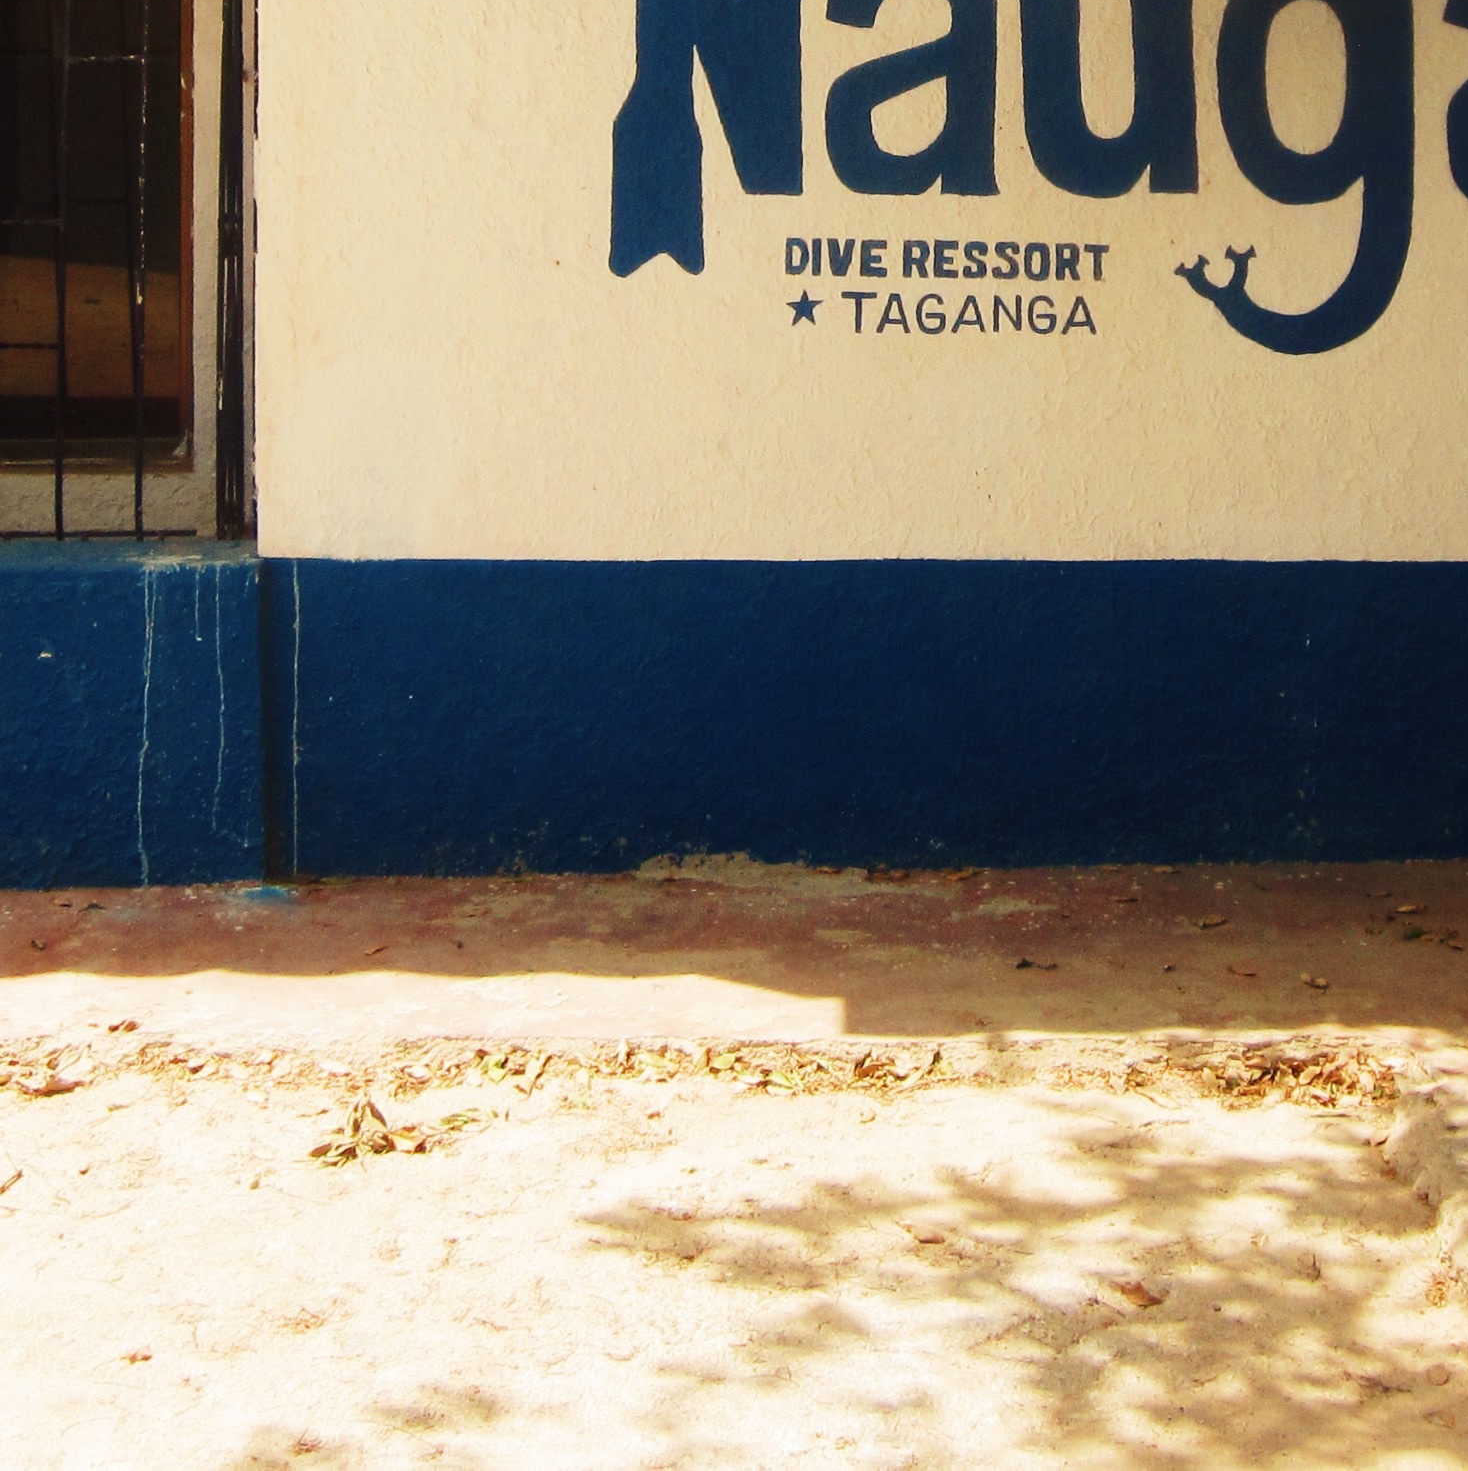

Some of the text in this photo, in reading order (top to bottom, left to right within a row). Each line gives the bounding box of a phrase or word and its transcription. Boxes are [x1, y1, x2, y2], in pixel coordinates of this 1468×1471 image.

[784, 237, 1110, 281] DIVE RESSORT
[841, 291, 1098, 335] TAGANGA
